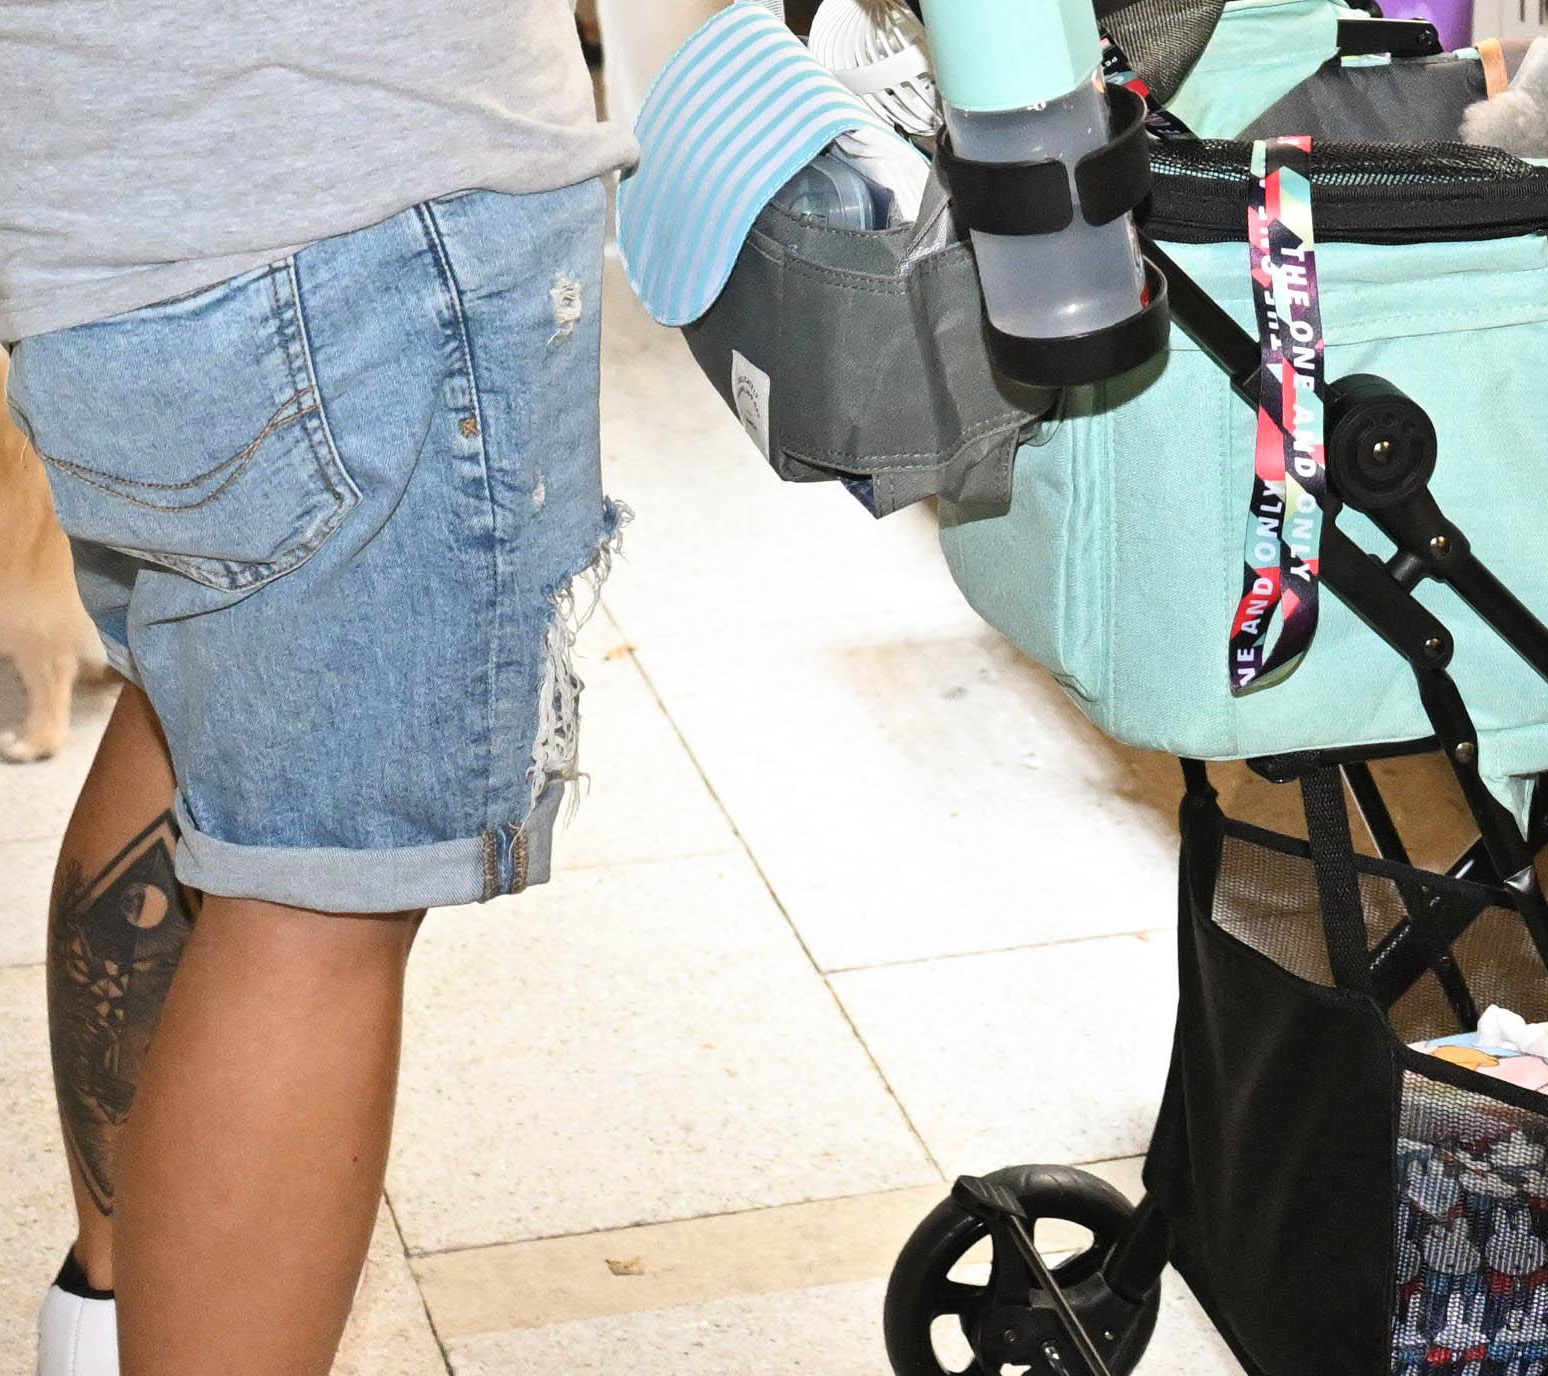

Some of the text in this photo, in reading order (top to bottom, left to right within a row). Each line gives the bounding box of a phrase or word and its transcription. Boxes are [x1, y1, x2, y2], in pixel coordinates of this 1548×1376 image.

[1280, 247, 1317, 583] THE ONE AND ONLY
[1254, 479, 1285, 564] ONLY
[1240, 575, 1275, 637] AND
